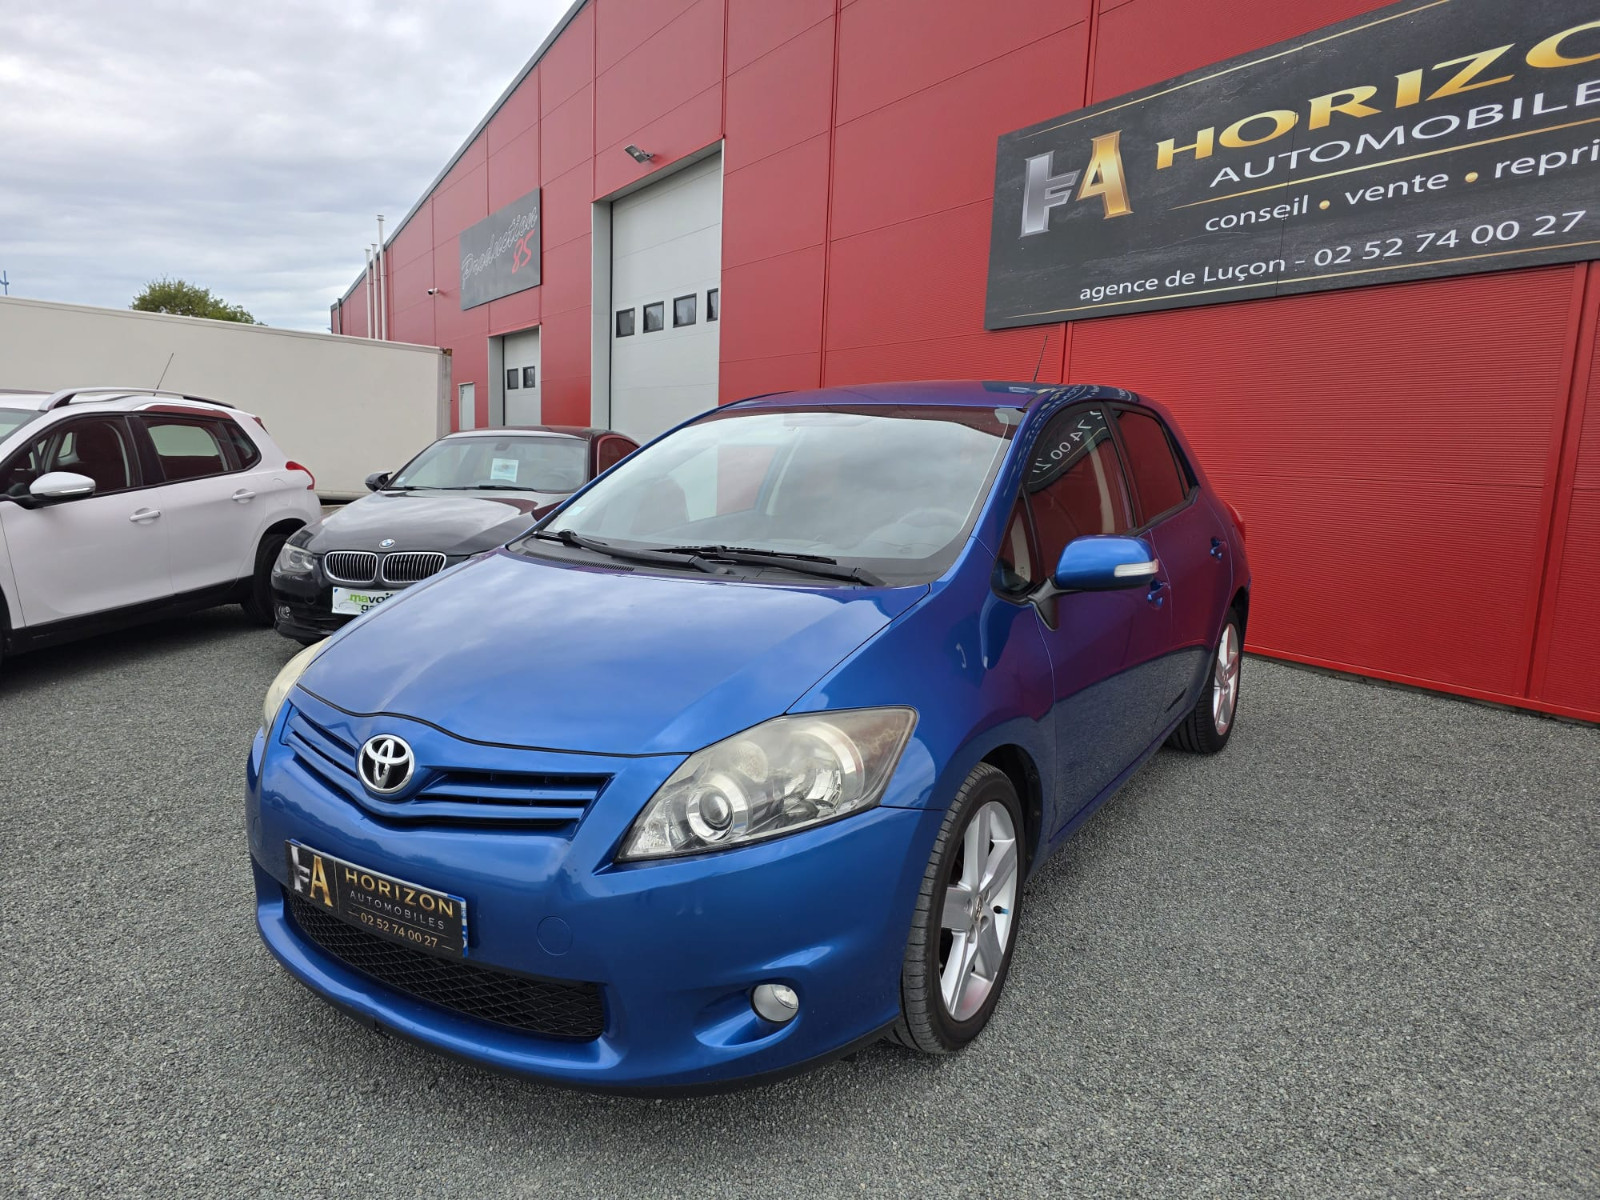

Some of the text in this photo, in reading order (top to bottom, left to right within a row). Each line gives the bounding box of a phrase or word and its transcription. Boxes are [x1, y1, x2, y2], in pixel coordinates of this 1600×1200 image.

[1156, 20, 1600, 170] HORIZO
[1209, 80, 1600, 188] AUTOMOBILE
[1205, 138, 1600, 231] conseil vente repri
[511, 229, 535, 274] 85
[1079, 278, 1159, 302] agence
[1165, 270, 1196, 287] de
[1203, 258, 1286, 282] Luçon
[1314, 245, 1352, 267] 02
[1362, 237, 1403, 261] 52
[1415, 228, 1460, 253] 74
[1470, 220, 1521, 245] 00
[1531, 210, 1587, 237] 27
[350, 592, 394, 604] mavoi
[345, 867, 454, 919] HORIZON
[350, 890, 446, 931] AUTOMOBILES
[360, 912, 438, 949] 02 52 74 00 27
